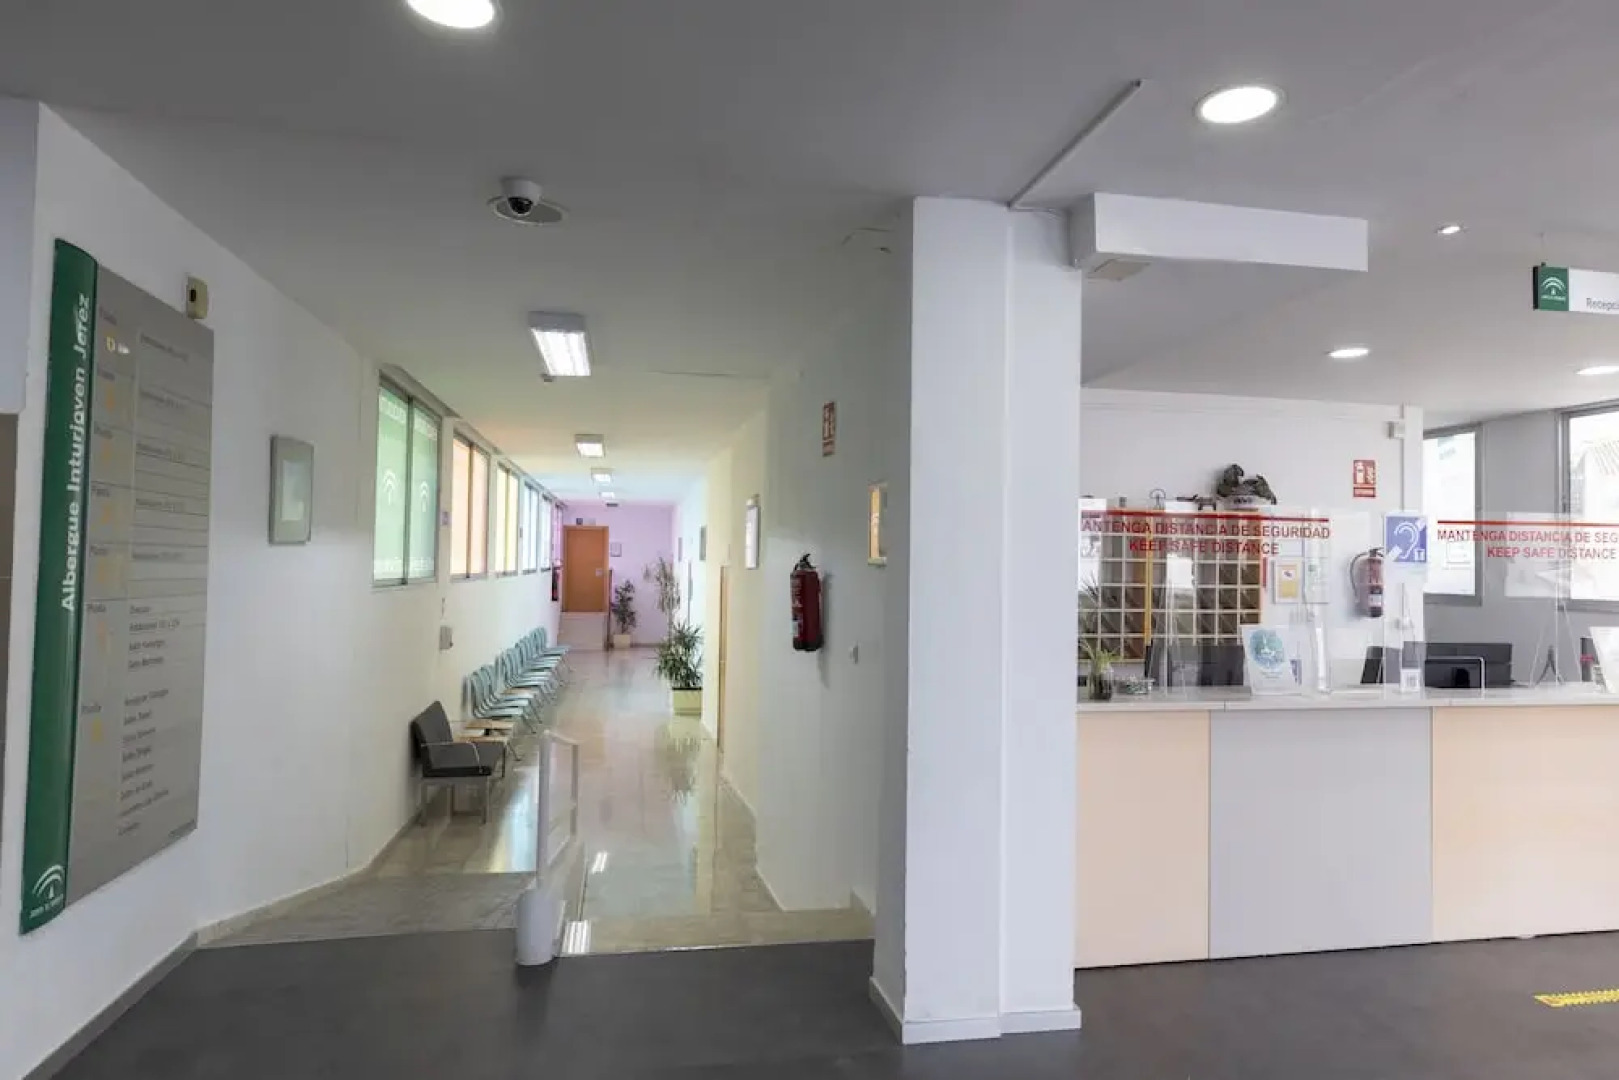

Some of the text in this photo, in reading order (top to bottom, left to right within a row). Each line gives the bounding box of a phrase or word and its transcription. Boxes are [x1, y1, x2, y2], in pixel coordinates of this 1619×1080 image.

[67, 367, 86, 492] Inturjoven
[1155, 521, 1227, 536] DISTANCIA
[1231, 524, 1249, 537] DE
[1254, 525, 1330, 539] SEGURIDAD
[1437, 529, 1506, 542] MANTENGA
[1509, 530, 1572, 543] DISTANCIA
[1575, 532, 1591, 543] DE
[1129, 540, 1280, 555] KEEP SAFE DISTANCE
[1487, 546, 1617, 560] KEEP SAFE DISTANCE
[61, 502, 80, 612] Albergue
